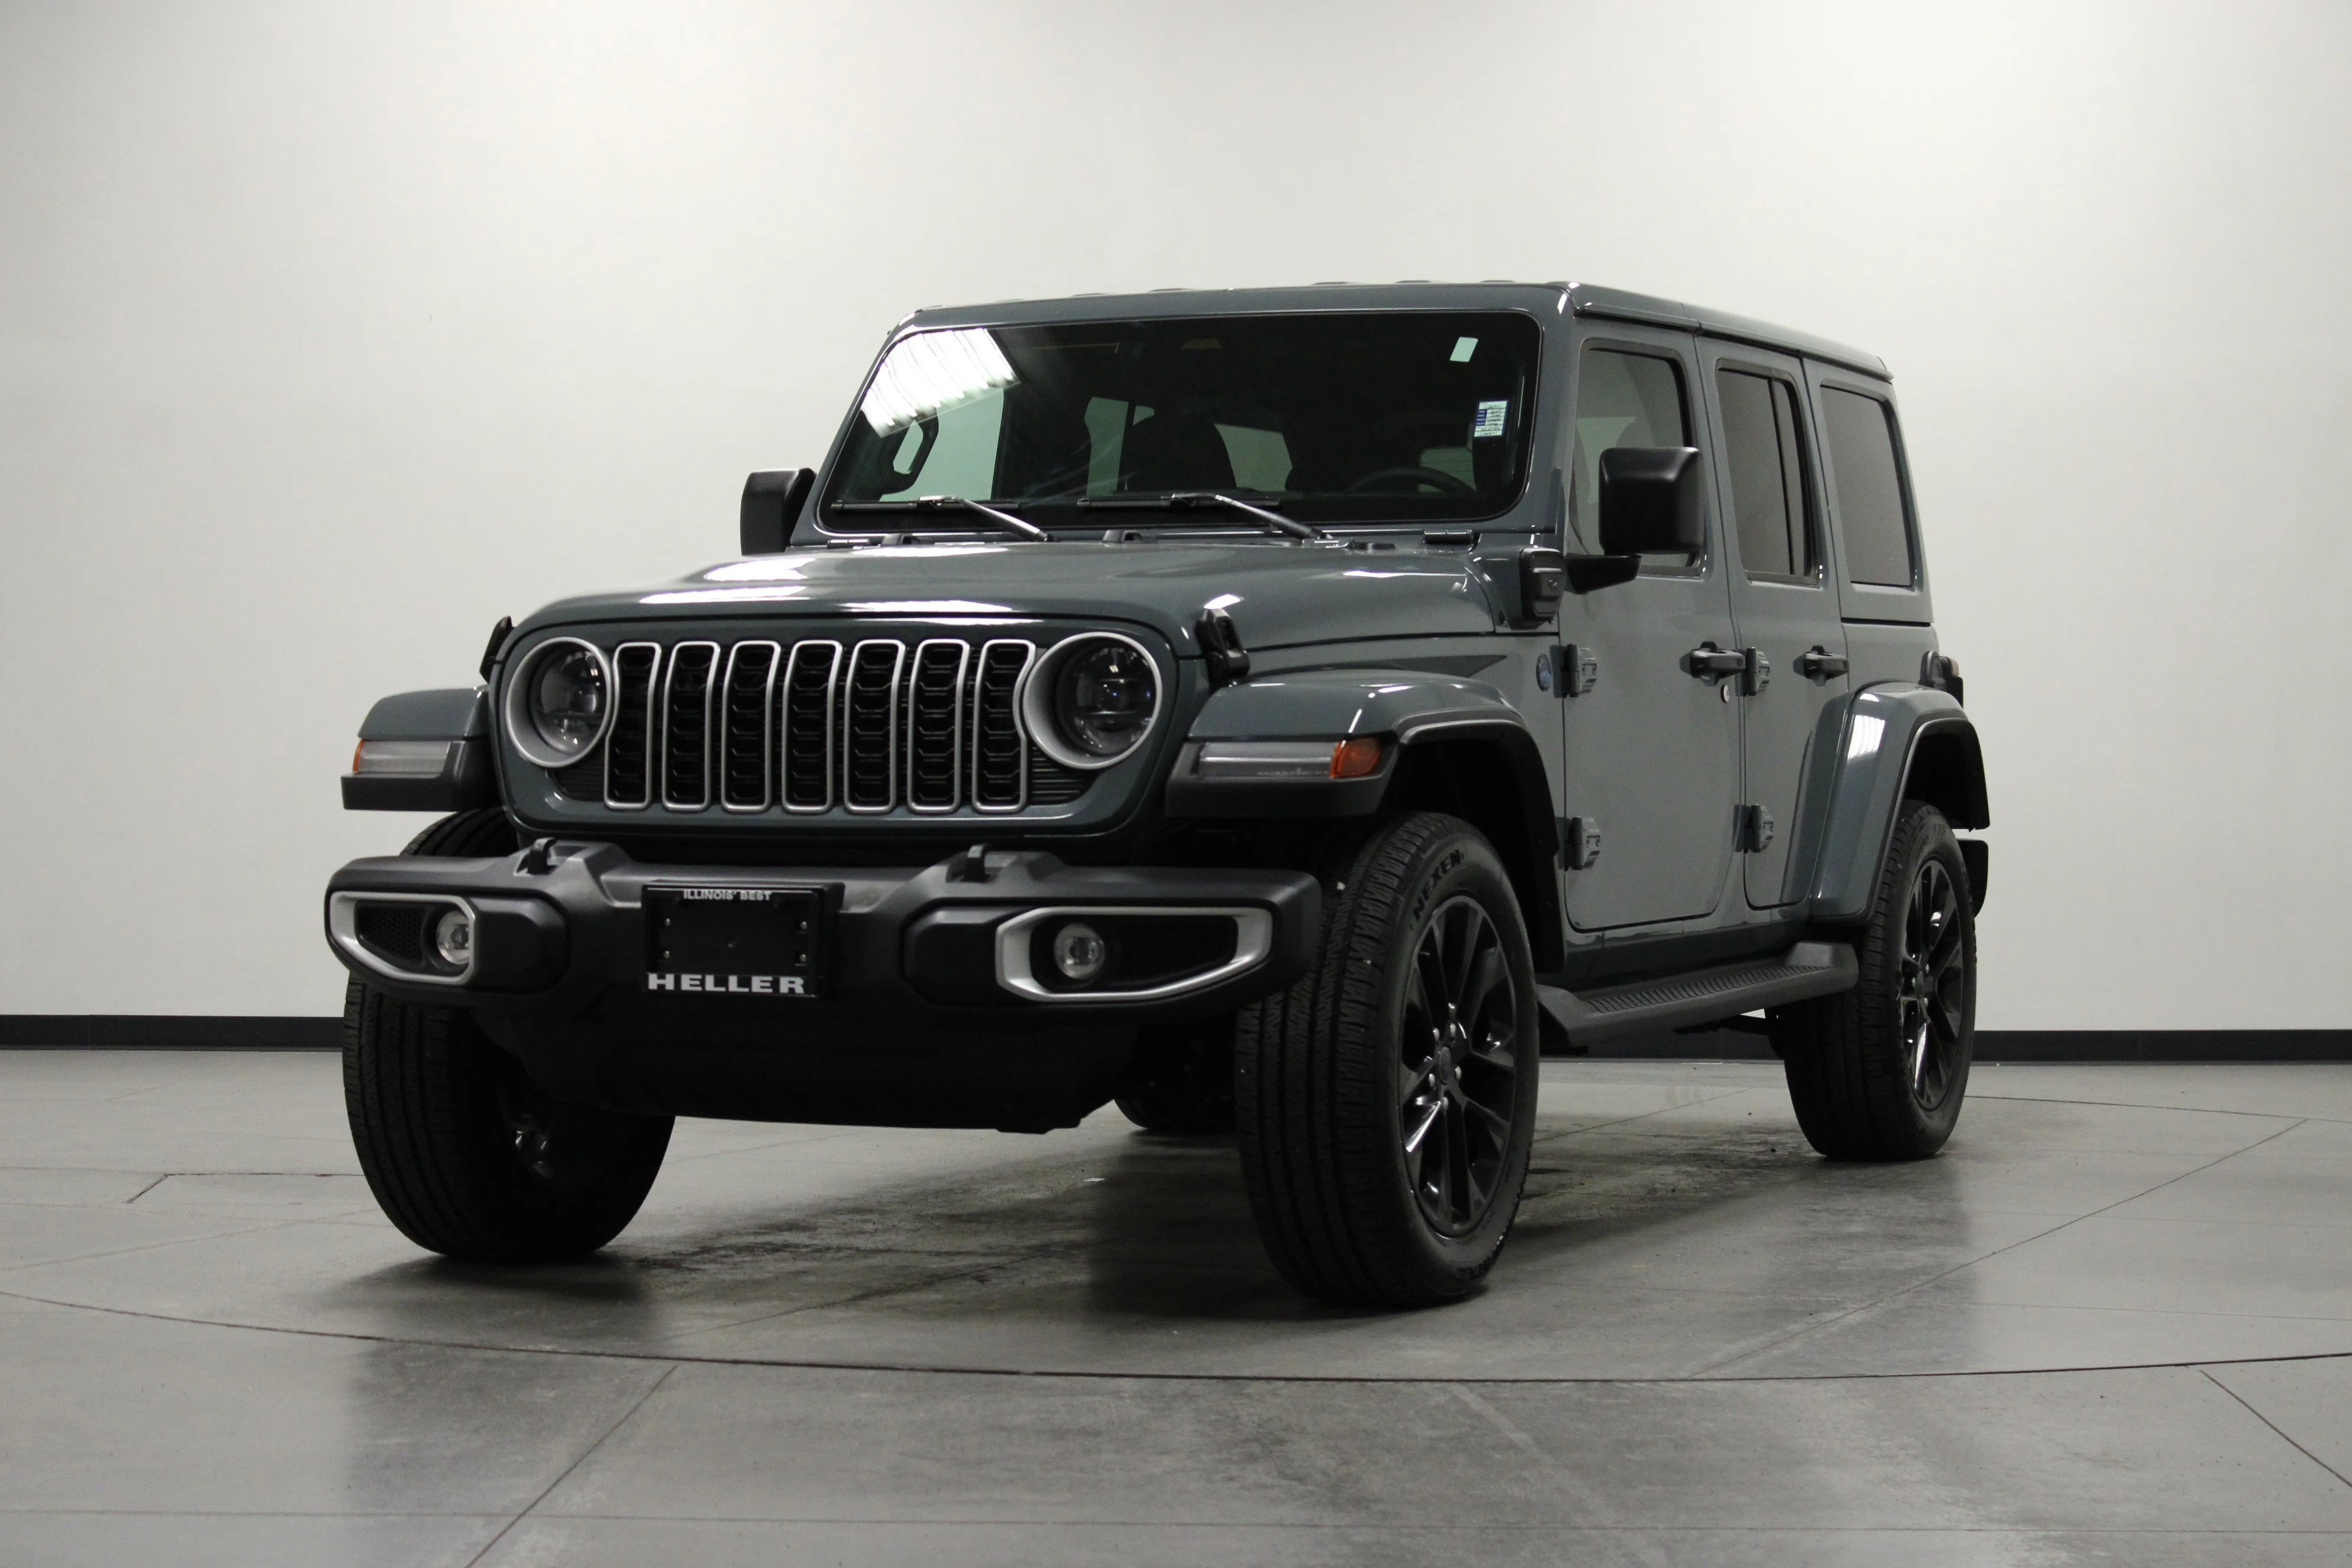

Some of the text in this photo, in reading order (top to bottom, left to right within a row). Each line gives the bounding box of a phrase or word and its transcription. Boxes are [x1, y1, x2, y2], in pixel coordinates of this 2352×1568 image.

[683, 889, 773, 901] ILLINOIS' BEST
[1413, 849, 1461, 922] NEXEN
[648, 974, 805, 994] HELLER
